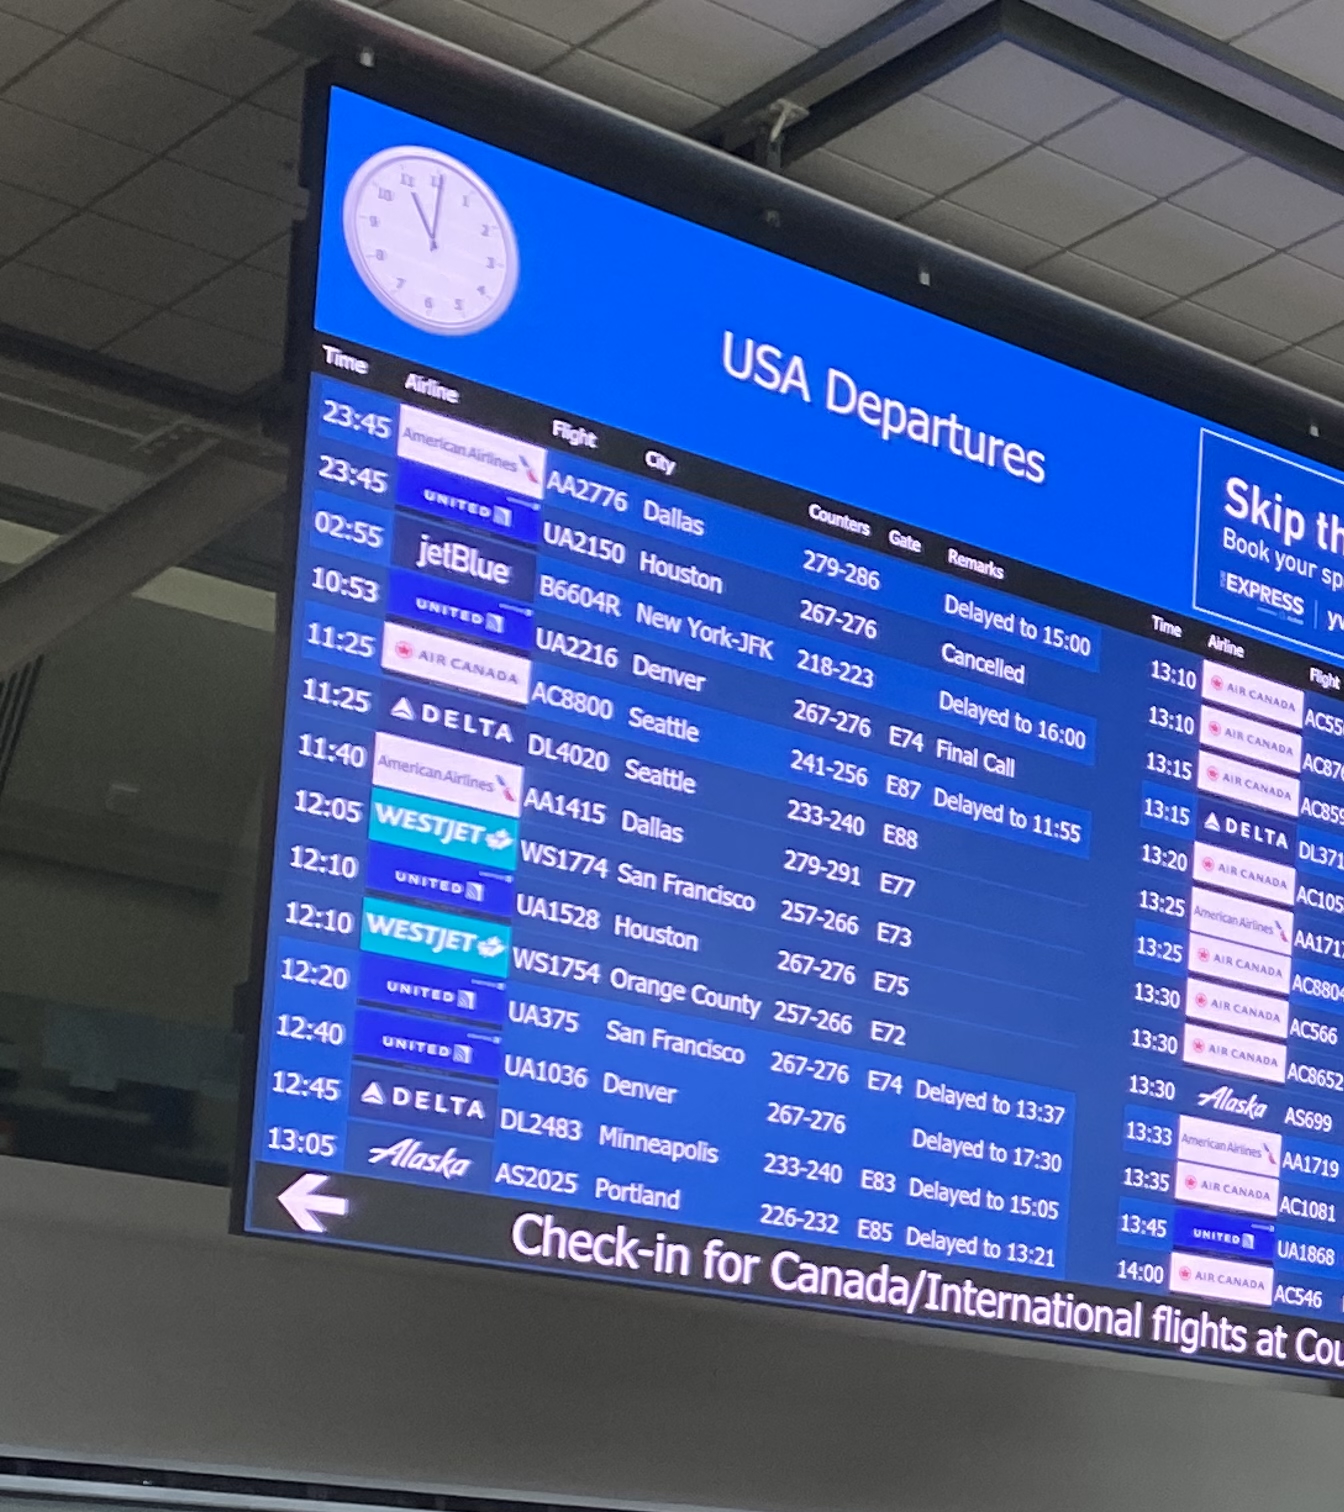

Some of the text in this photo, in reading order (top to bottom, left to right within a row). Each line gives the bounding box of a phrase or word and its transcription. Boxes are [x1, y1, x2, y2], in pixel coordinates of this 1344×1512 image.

[722, 330, 1046, 485] USA Departures
[322, 399, 1091, 657] 23:45 American Airlines AA2776 Dallas 279-286 Delayed to 15:00
[1222, 526, 1270, 563] Book
[1274, 548, 1316, 580] your
[1224, 475, 1305, 545] Skip
[1225, 571, 1305, 616] EXPRESS
[268, 1126, 1055, 1268] 13:05 Alaska AS2025 Portland 226-232 E85 Delayed to 13:21
[511, 1213, 690, 1278] Check-in
[703, 1238, 760, 1287] for
[770, 1250, 1141, 1340] Canada/International
[1152, 1305, 1247, 1355] flights
[1256, 1325, 1287, 1358] at
